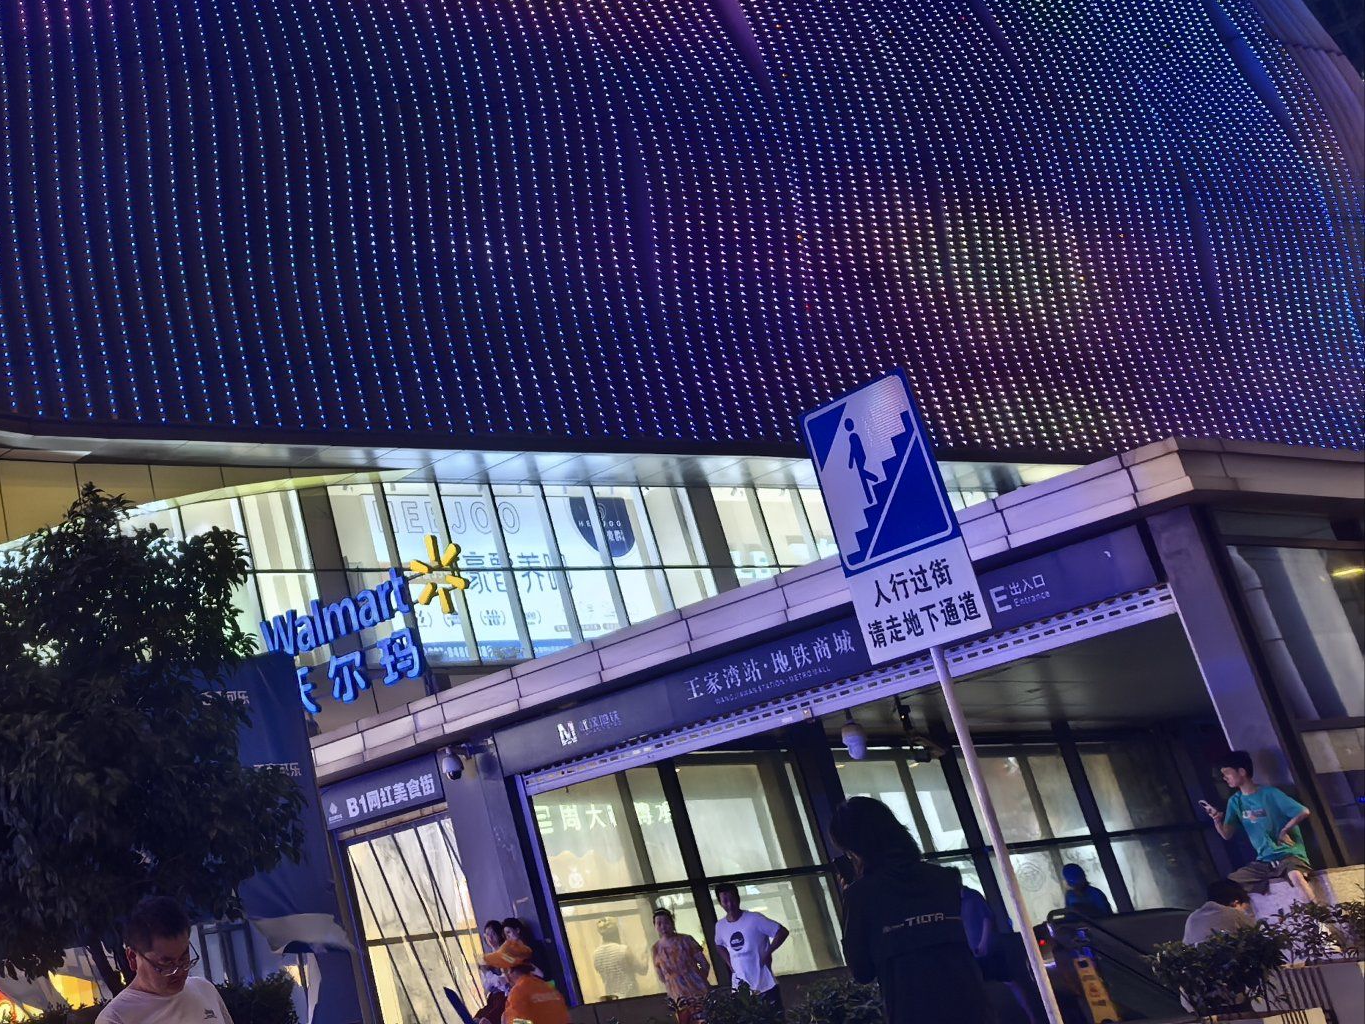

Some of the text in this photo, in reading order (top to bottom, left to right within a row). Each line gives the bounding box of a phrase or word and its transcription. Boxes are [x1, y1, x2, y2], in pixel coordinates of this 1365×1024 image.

[874, 558, 953, 608] 人行过街
[989, 585, 1012, 613] E
[1008, 574, 1046, 596] 出入口
[1013, 590, 1051, 607] Entrance
[260, 567, 410, 656] Walmart
[867, 590, 981, 649] 请走地下通道
[684, 629, 856, 701] 王家湾站·地铁商城
[345, 773, 435, 818] B1网红美食街
